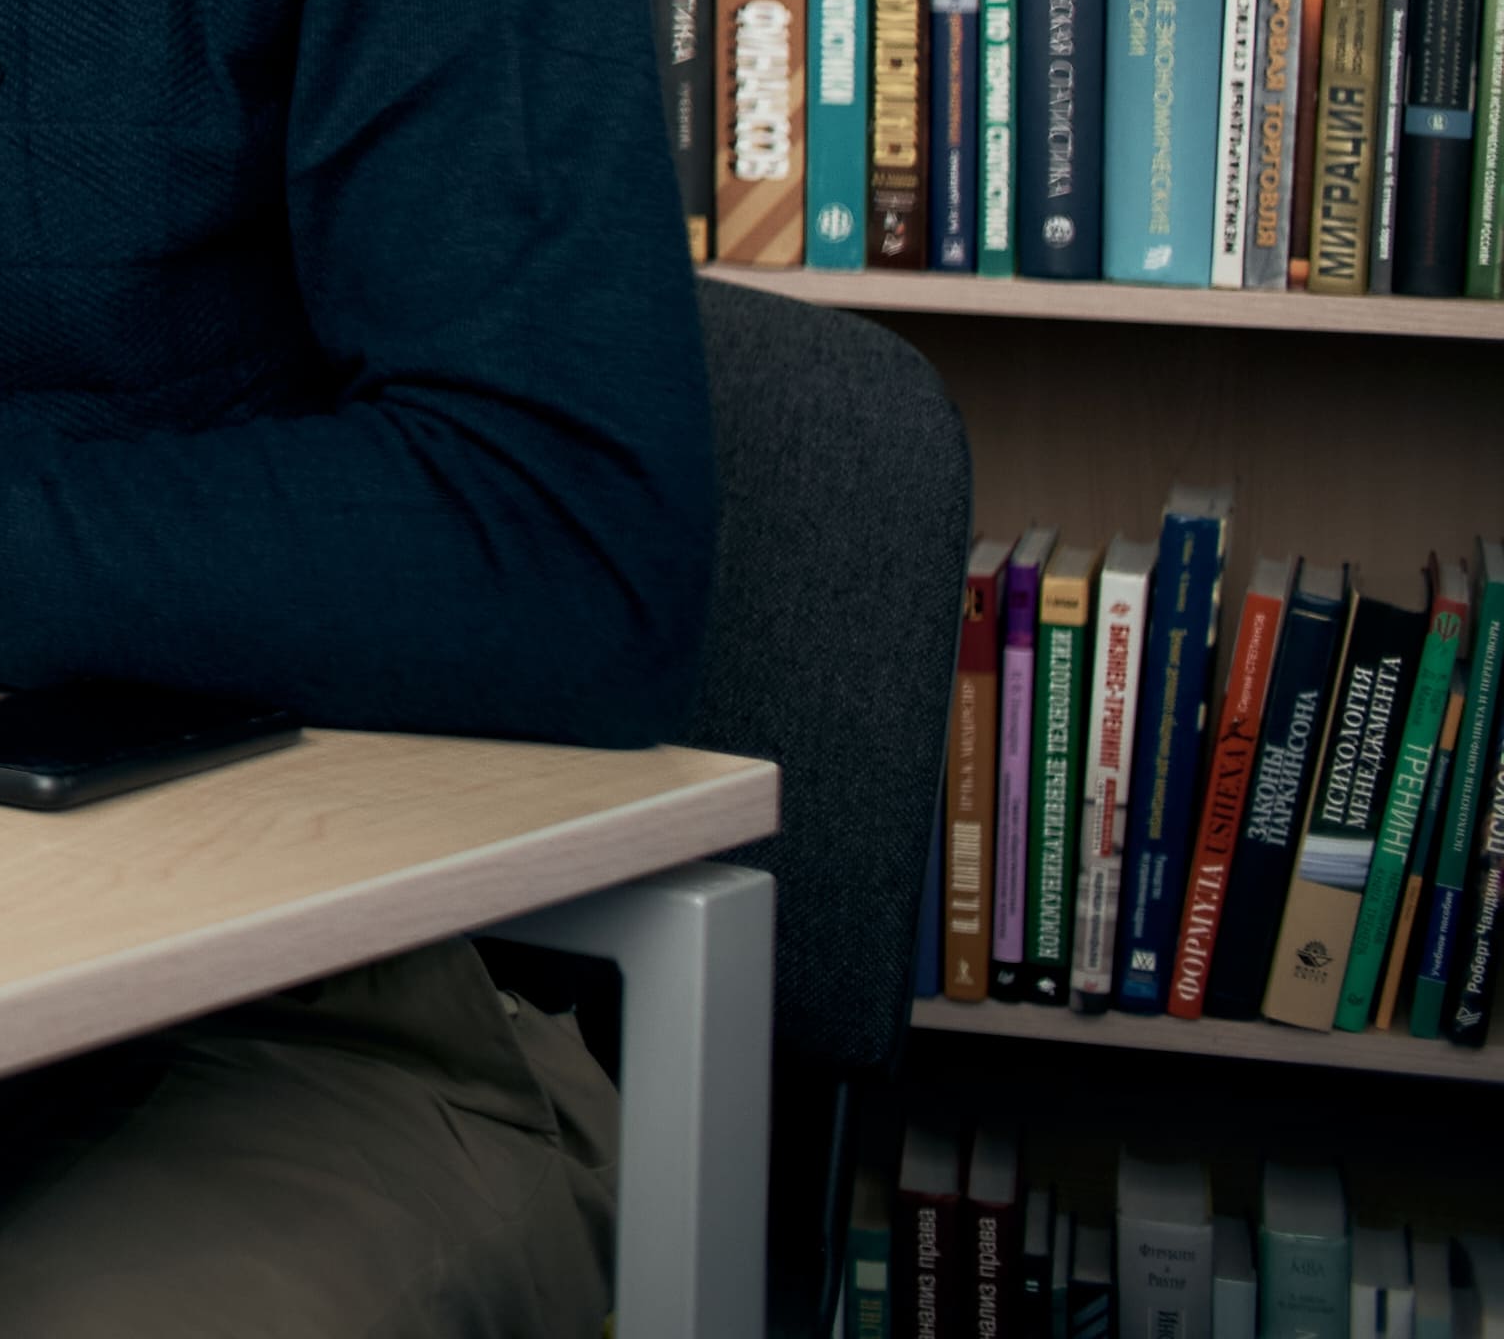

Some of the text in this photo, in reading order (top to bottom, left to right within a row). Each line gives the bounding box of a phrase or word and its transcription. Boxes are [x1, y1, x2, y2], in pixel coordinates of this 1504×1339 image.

[986, 6, 1009, 41] ПО
[1047, 59, 1075, 197] СТАТИСТИКА
[1149, 19, 1175, 235] ЭКОНОМИЧЕСКИЕ
[1223, 81, 1245, 254] МЕЖДУНАРОДНЫЙ
[1256, 100, 1286, 248] ТОРГОВЛЯ
[1318, 86, 1366, 280] МИГРАЦИЯ
[1483, 171, 1496, 221] СОЗНАНИИ
[1486, 96, 1500, 169] ИСТОРИЧЕСКОМ
[1479, 222, 1492, 265] РОССИЯН
[1099, 623, 1131, 770] БИЗНЕС-ТРЕНИНГ
[1237, 612, 1266, 713] Сергей СТЕПАНОВ
[1038, 629, 1073, 960] КОММУНИКАТИВНЫЕ ТЕХНОЛОГИИ
[1247, 742, 1284, 842] ЗАКОНЫ
[1267, 689, 1318, 846] ПАРКИНСОНА
[1322, 663, 1374, 823] ПСИХОЛОГИЯ
[1347, 656, 1402, 829] МЕНЕДЖМЕНТА
[1382, 742, 1433, 865] ТРЕНИНГ
[1453, 620, 1501, 852] ПСИХОЛОГИЯ КОНФЛИКТА И ПЕРЕГОВОРЫ
[1174, 863, 1224, 1002] ФОРМУЛА
[1428, 891, 1455, 978] Учебное пособие
[1467, 869, 1501, 993] Роберт Чалдини
[917, 1207, 942, 1268] права
[977, 1216, 1003, 1278] права
